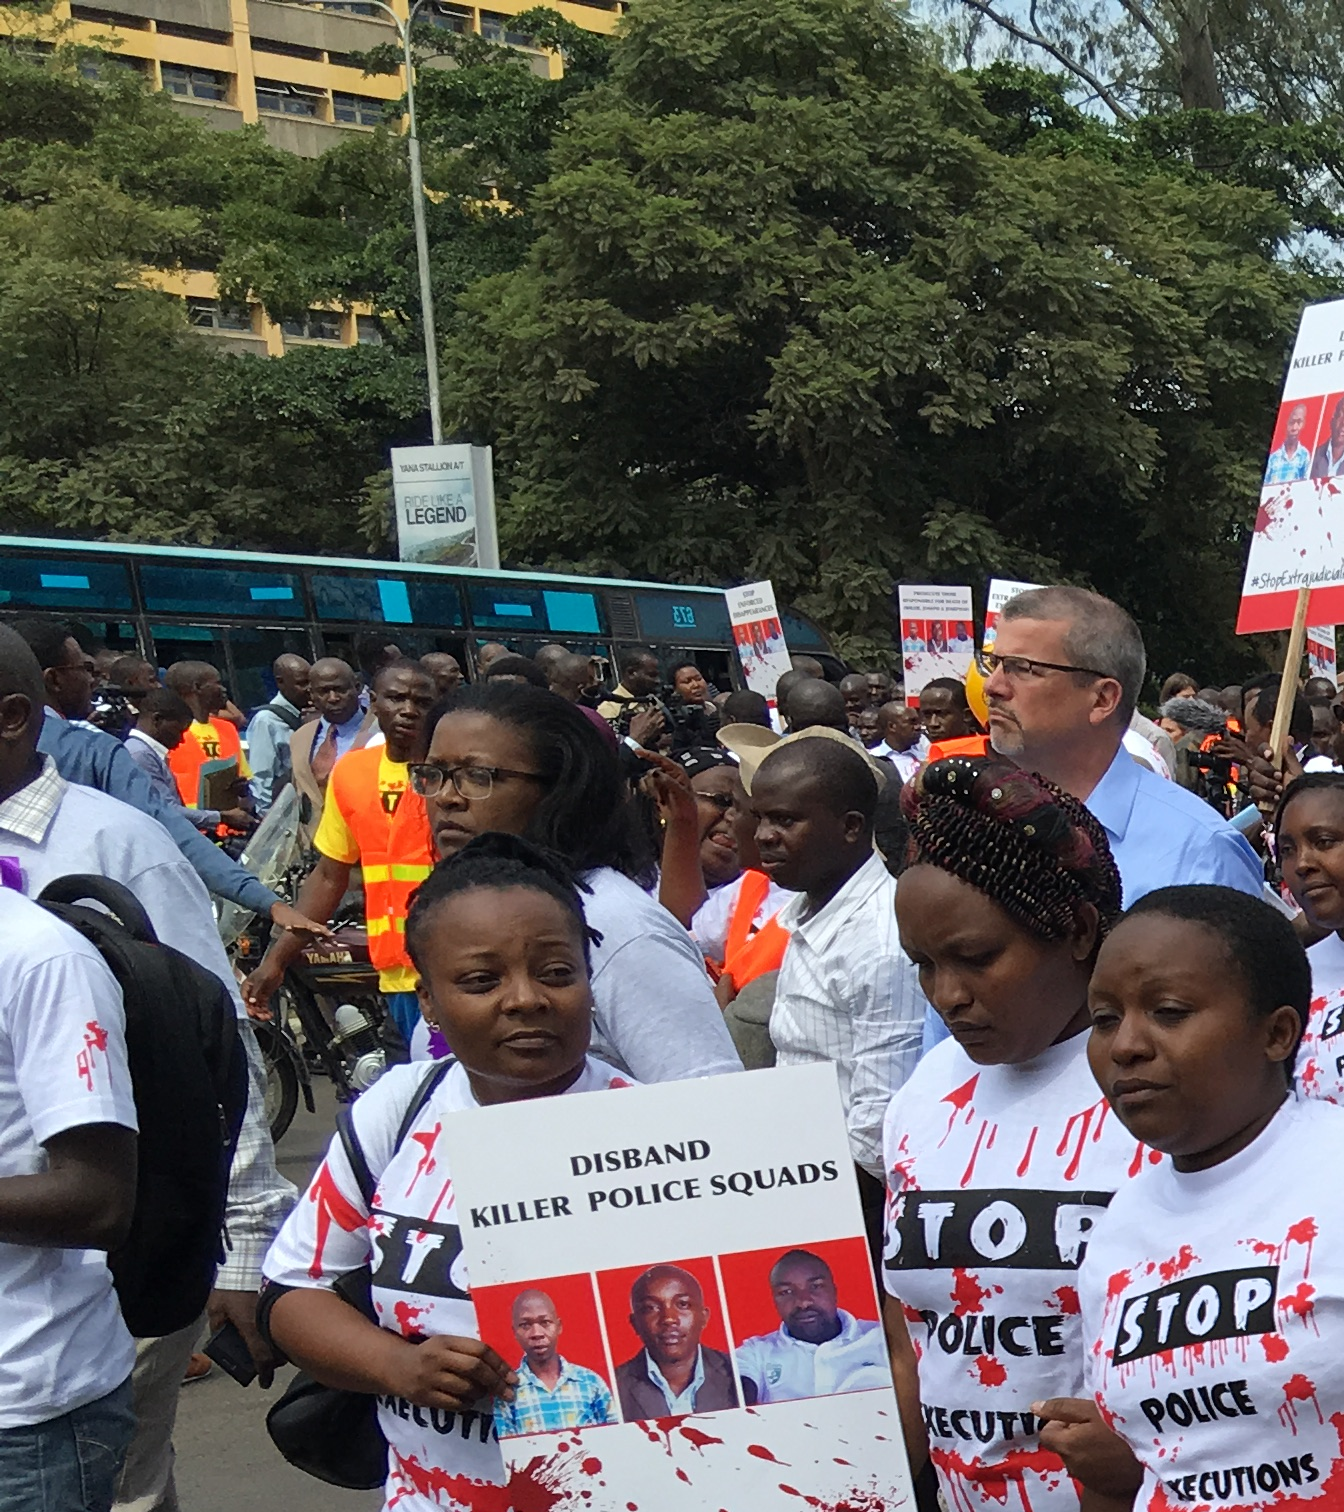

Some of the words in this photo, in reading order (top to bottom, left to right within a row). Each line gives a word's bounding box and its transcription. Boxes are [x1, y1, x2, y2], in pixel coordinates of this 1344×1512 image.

[1292, 352, 1333, 370] KILLER
[404, 495, 428, 507] RIDE
[431, 494, 453, 506] LIKE
[406, 506, 467, 525] LEGEND
[570, 1139, 712, 1177] DISBAND
[470, 1195, 573, 1228] KILLER
[588, 1178, 702, 1213] POLICE
[710, 1160, 839, 1196] SQUADS
[1118, 1277, 1273, 1357] STOP
[1140, 1379, 1258, 1434] POLICE
[1166, 1453, 1321, 1502] XECUTIONS
